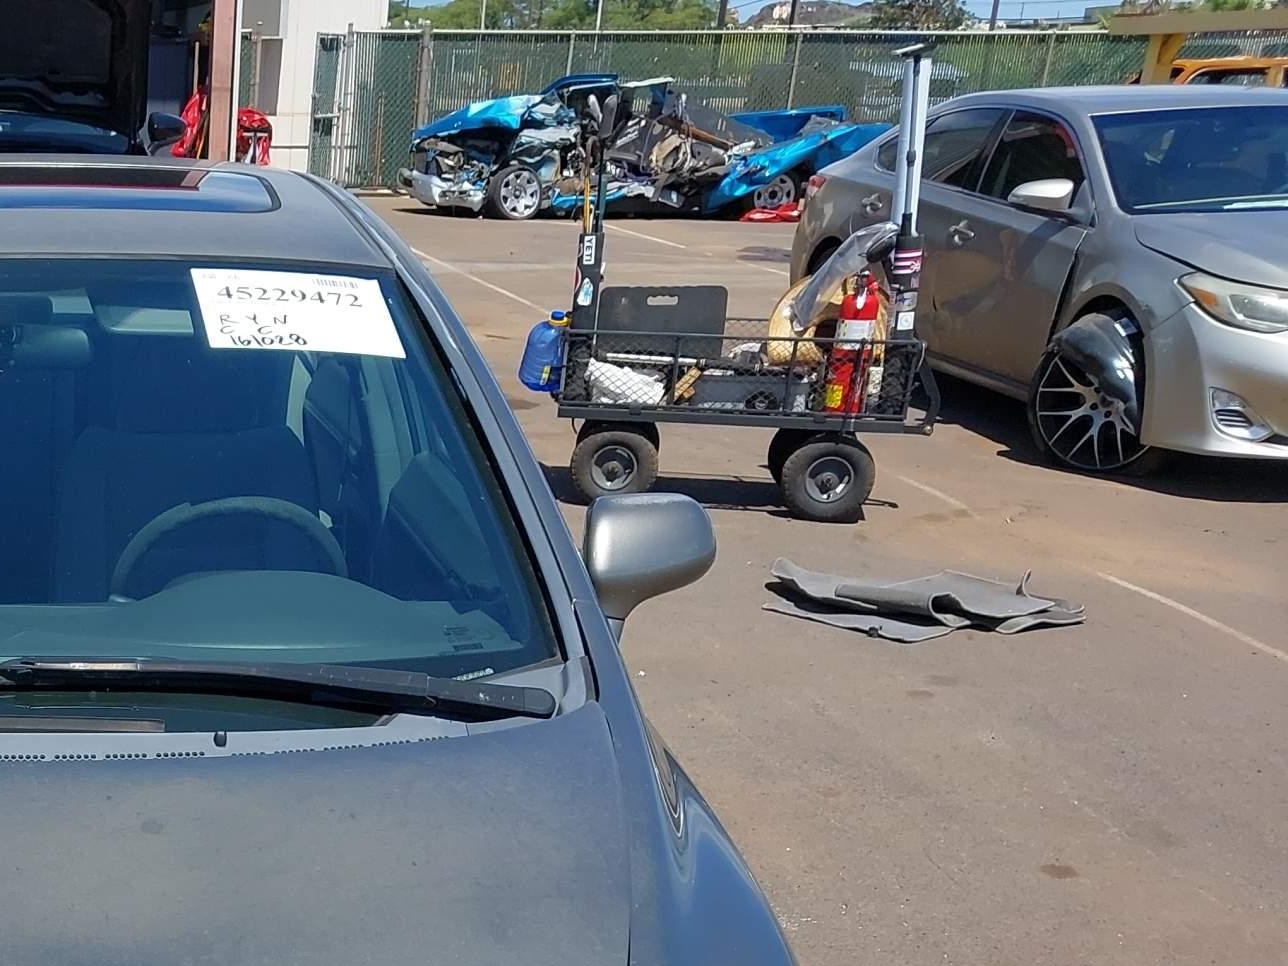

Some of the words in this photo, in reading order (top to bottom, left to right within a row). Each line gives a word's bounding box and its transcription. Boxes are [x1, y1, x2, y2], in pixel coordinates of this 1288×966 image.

[584, 236, 594, 263] YETI
[217, 285, 363, 308] 45229472
[273, 314, 288, 325] N
